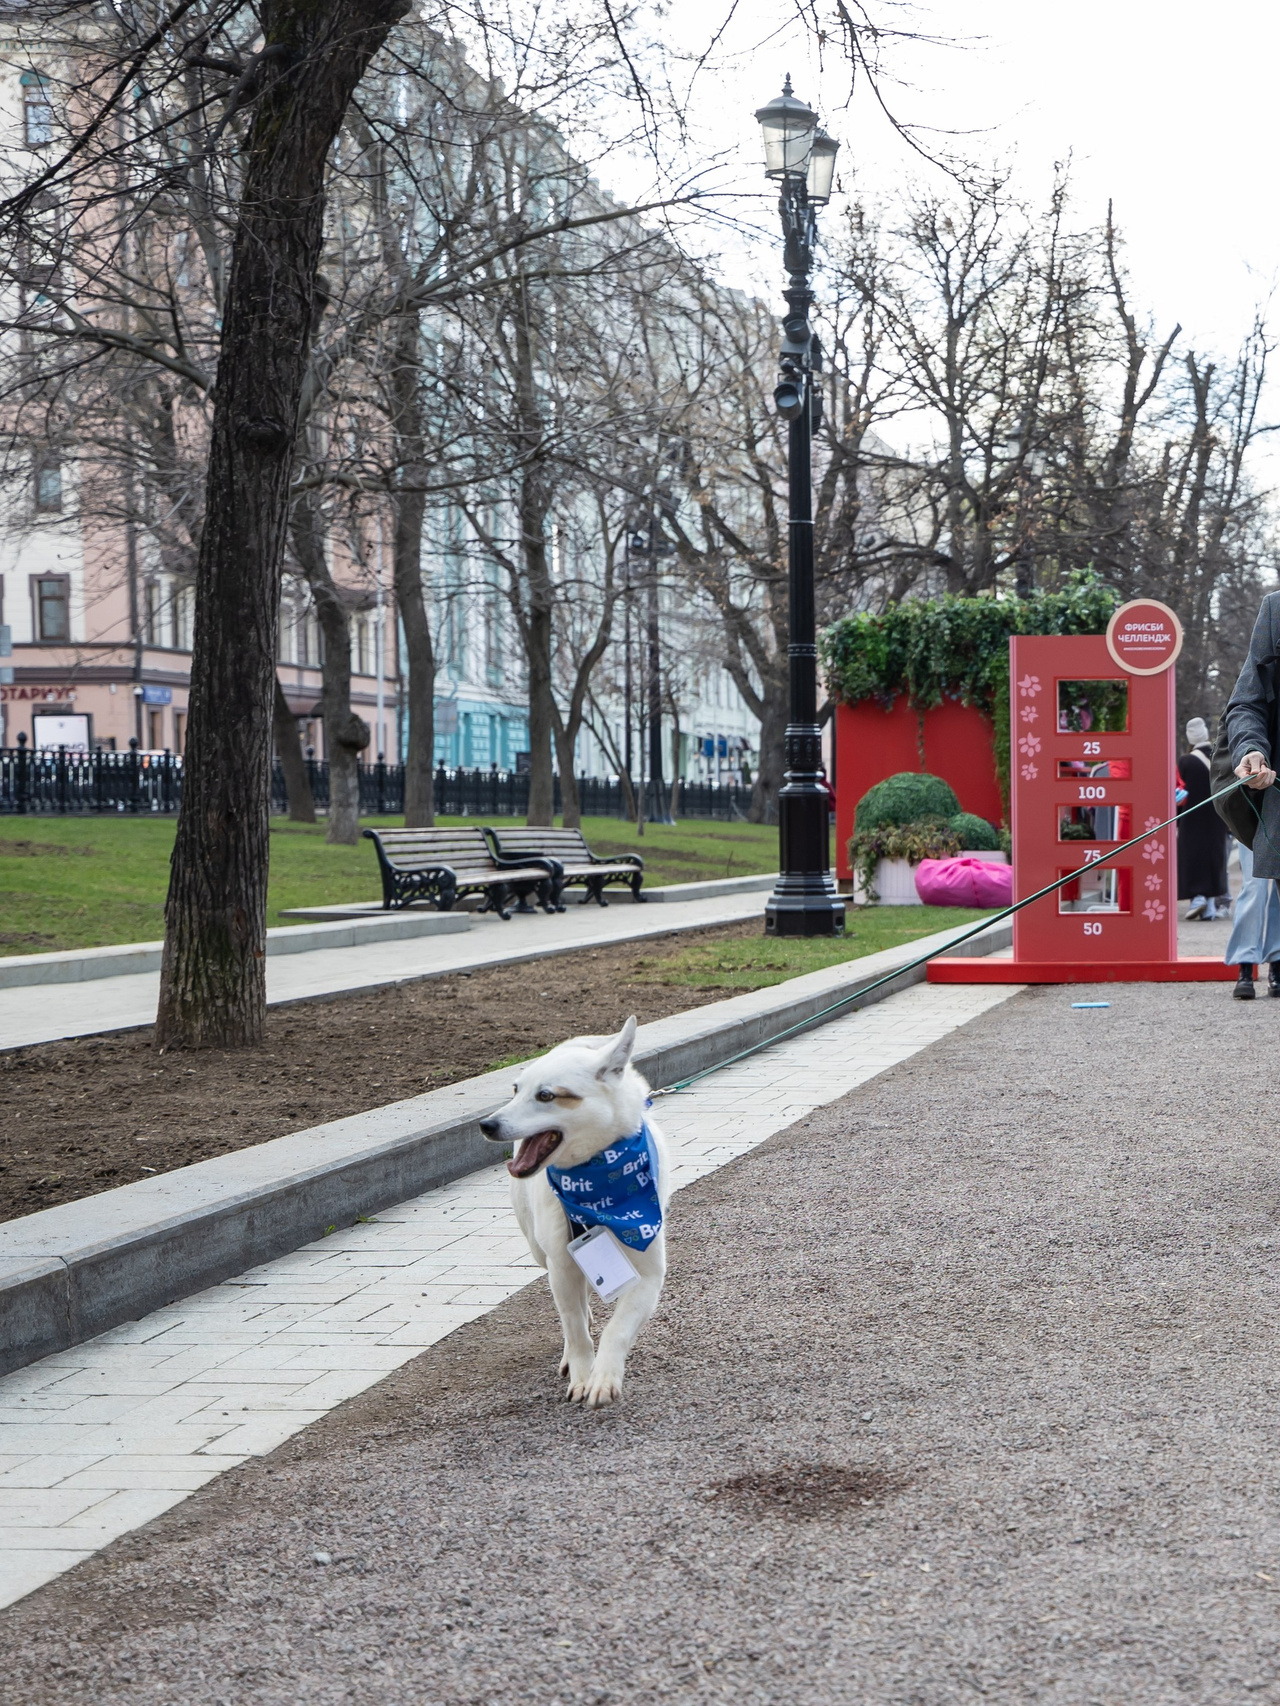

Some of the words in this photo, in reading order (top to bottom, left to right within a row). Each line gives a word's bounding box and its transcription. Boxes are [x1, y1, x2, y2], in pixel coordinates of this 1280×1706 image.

[1124, 622, 1164, 632] ФРИСБИ
[1117, 633, 1171, 643] ЧЕЛЛЕНДЖ
[1083, 741, 1101, 754] 25
[1078, 786, 1106, 799] 100
[1083, 850, 1102, 863] 75
[1083, 922, 1102, 935] 50
[623, 1151, 648, 1175] Brit
[560, 1175, 593, 1192] Brit
